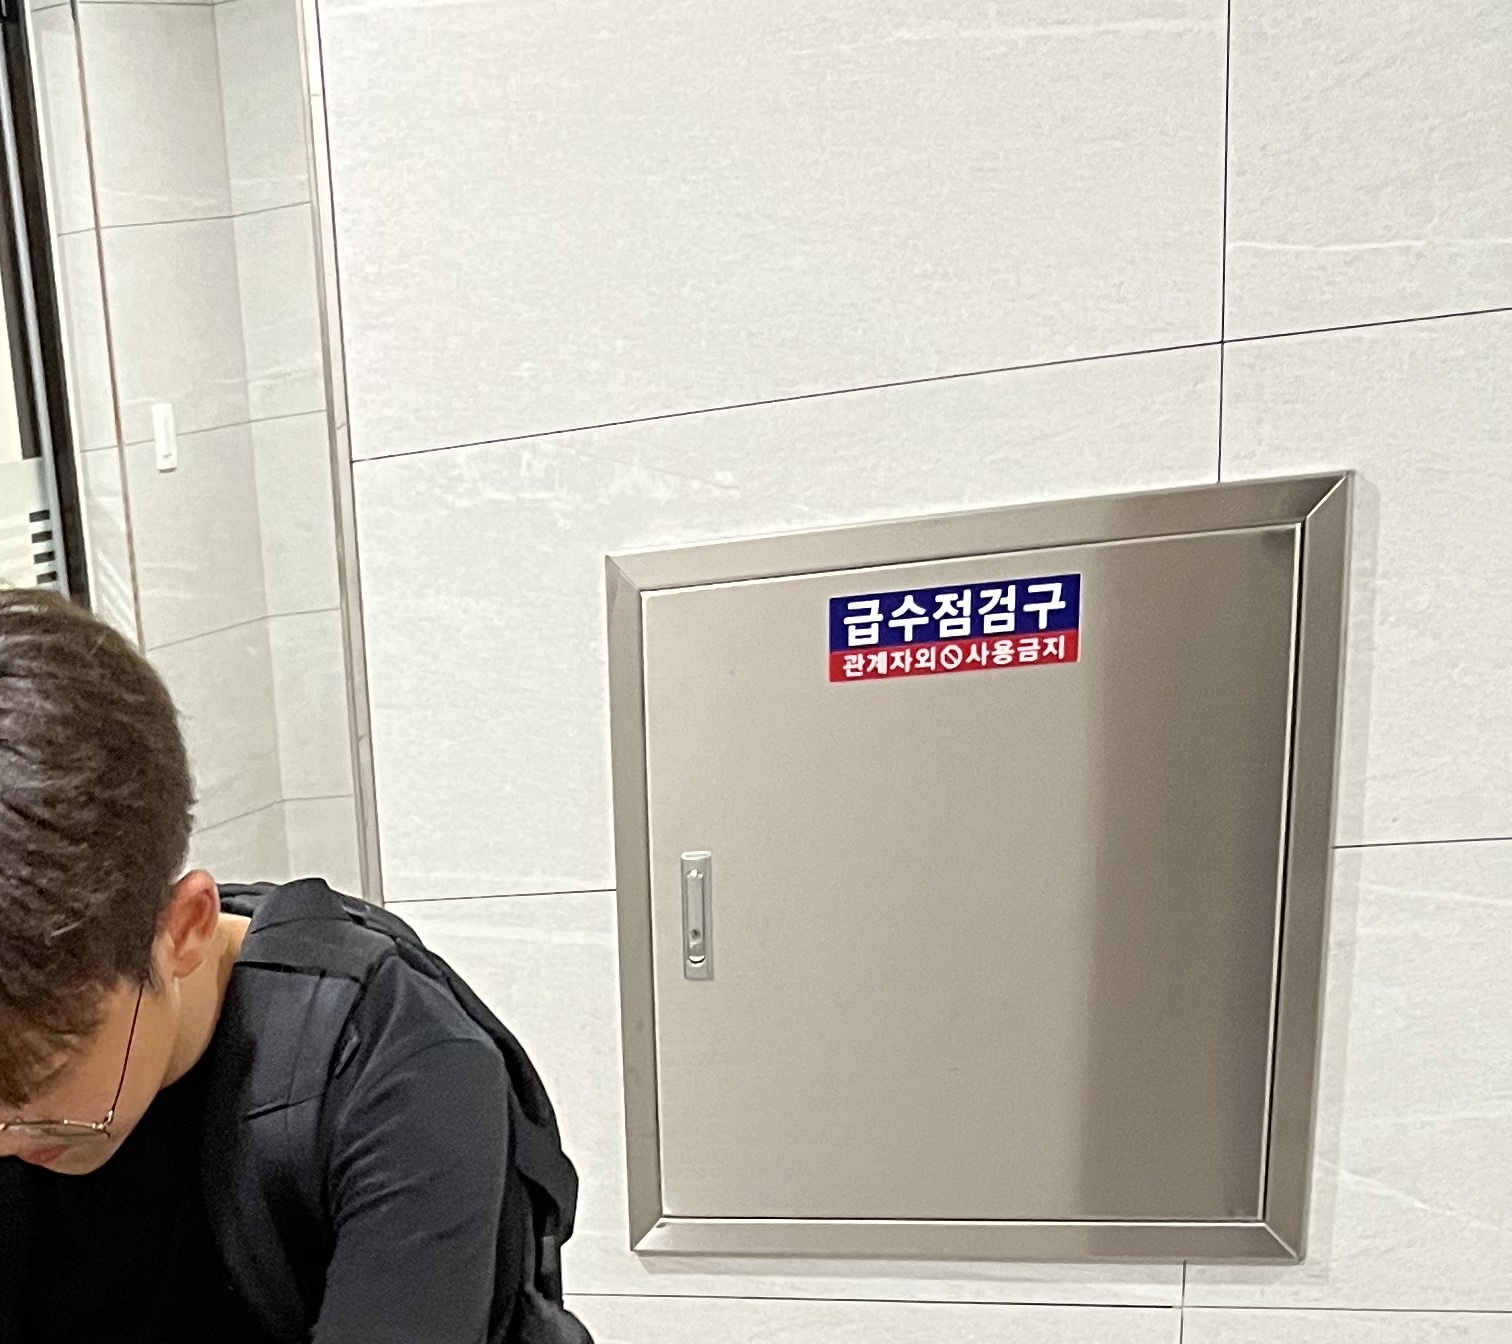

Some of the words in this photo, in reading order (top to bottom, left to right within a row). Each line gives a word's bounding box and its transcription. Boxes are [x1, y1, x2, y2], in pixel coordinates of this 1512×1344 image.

[843, 582, 1067, 647] 급수점검구
[843, 646, 937, 678] 관계자외
[965, 635, 1066, 667] 사용금지
